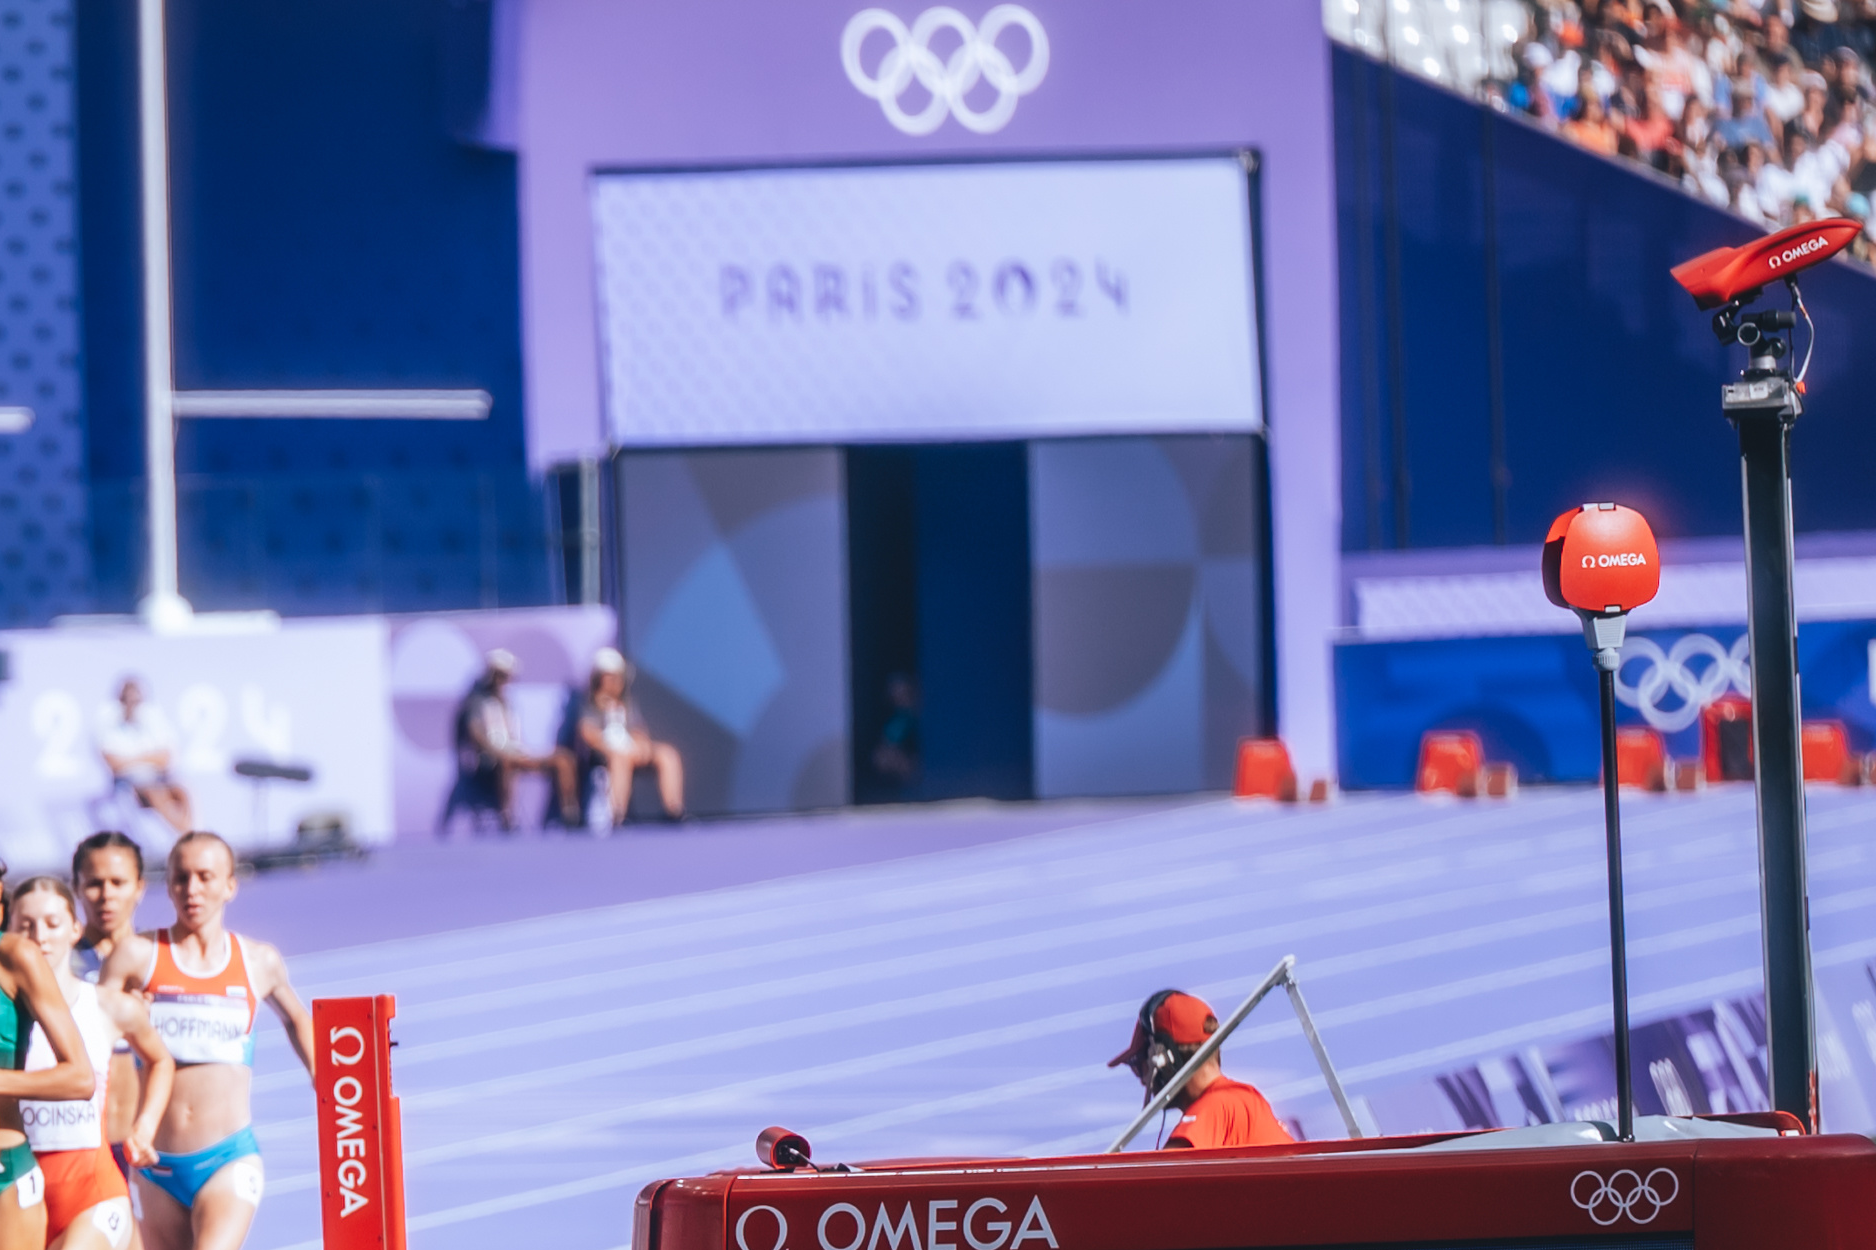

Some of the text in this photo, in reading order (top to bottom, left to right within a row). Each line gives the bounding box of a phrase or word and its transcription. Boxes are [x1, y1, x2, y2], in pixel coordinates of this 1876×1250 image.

[1782, 236, 1828, 263] OMEGA
[721, 255, 1130, 322] PARIS 2024
[1598, 552, 1646, 568] OMEGA
[333, 1076, 369, 1218] OMEGA
